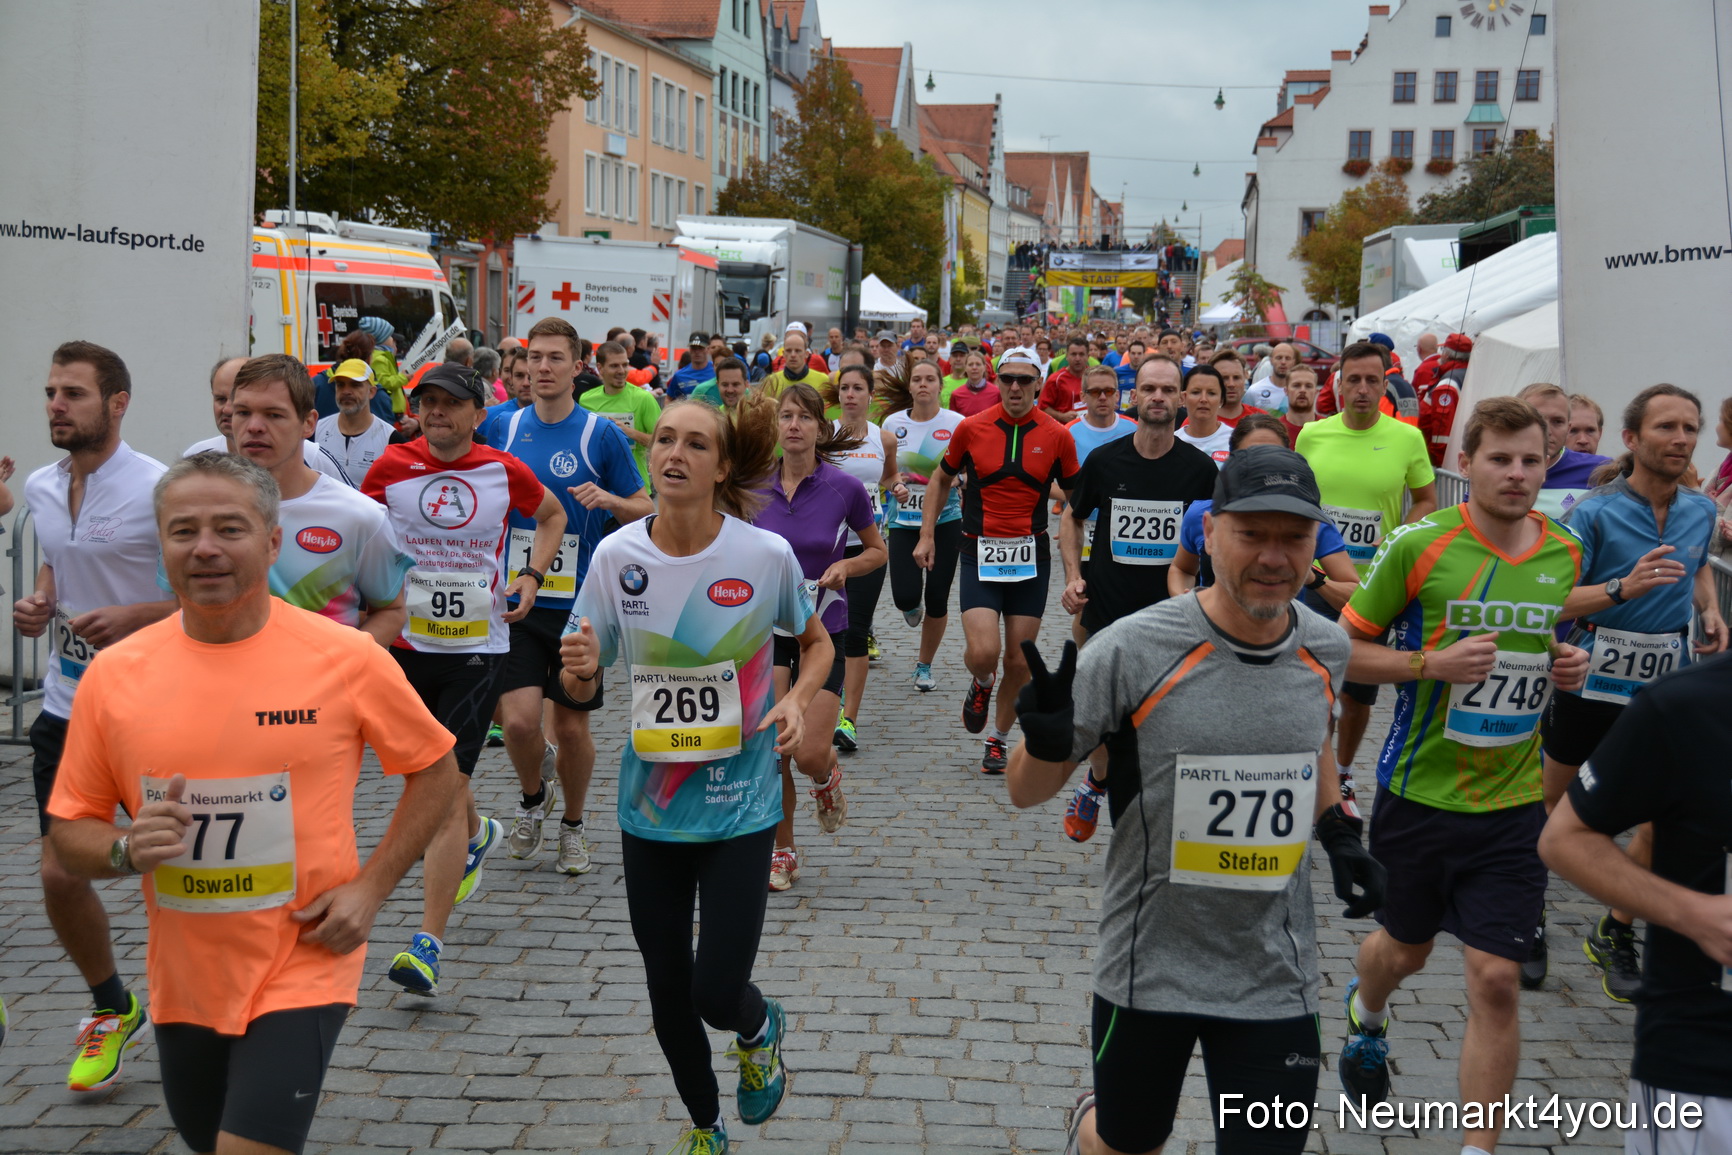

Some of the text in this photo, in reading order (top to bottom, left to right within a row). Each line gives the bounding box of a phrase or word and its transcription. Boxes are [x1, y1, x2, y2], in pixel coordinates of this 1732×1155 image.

[1605, 244, 1732, 270] www.bmw-
[1082, 274, 1120, 284] START
[586, 283, 638, 294] Bayerisches
[585, 294, 609, 303] Rotes
[584, 306, 609, 314] Kreuz
[1114, 505, 1171, 514] PARTL Neumarkt
[1342, 512, 1372, 520] Neumarkt
[1118, 515, 1176, 540] 2236
[1331, 520, 1375, 544] 780
[302, 532, 337, 547] Hervis
[512, 534, 532, 543] PARTL
[984, 546, 1031, 563] 2570
[1126, 545, 1164, 556] Andreas
[416, 558, 484, 569] Leistungsdiagnostik
[523, 546, 564, 573] 16
[411, 577, 476, 588] PARTL Neumarkt
[714, 586, 748, 600] Hervis
[432, 591, 465, 618] 95
[622, 600, 650, 610] PARTL
[427, 622, 469, 636] Michael
[1598, 634, 1669, 648] PARTL Neumarkt
[1498, 660, 1544, 672] Neumarkt
[1599, 648, 1673, 678] 2190
[634, 674, 666, 684] PARTL
[1462, 674, 1548, 710] 2748
[1594, 679, 1640, 694] Hans-J
[654, 686, 720, 724] 269
[256, 710, 317, 726] THULE
[1480, 719, 1518, 733] Arthur
[671, 733, 702, 747] Sina
[1180, 769, 1298, 782] PARTL Neumarkt
[191, 790, 264, 805] Neumarkt
[1206, 788, 1294, 838] 278
[192, 812, 244, 860] 77
[1218, 851, 1279, 871] Stefan
[184, 874, 254, 894] Oswald
